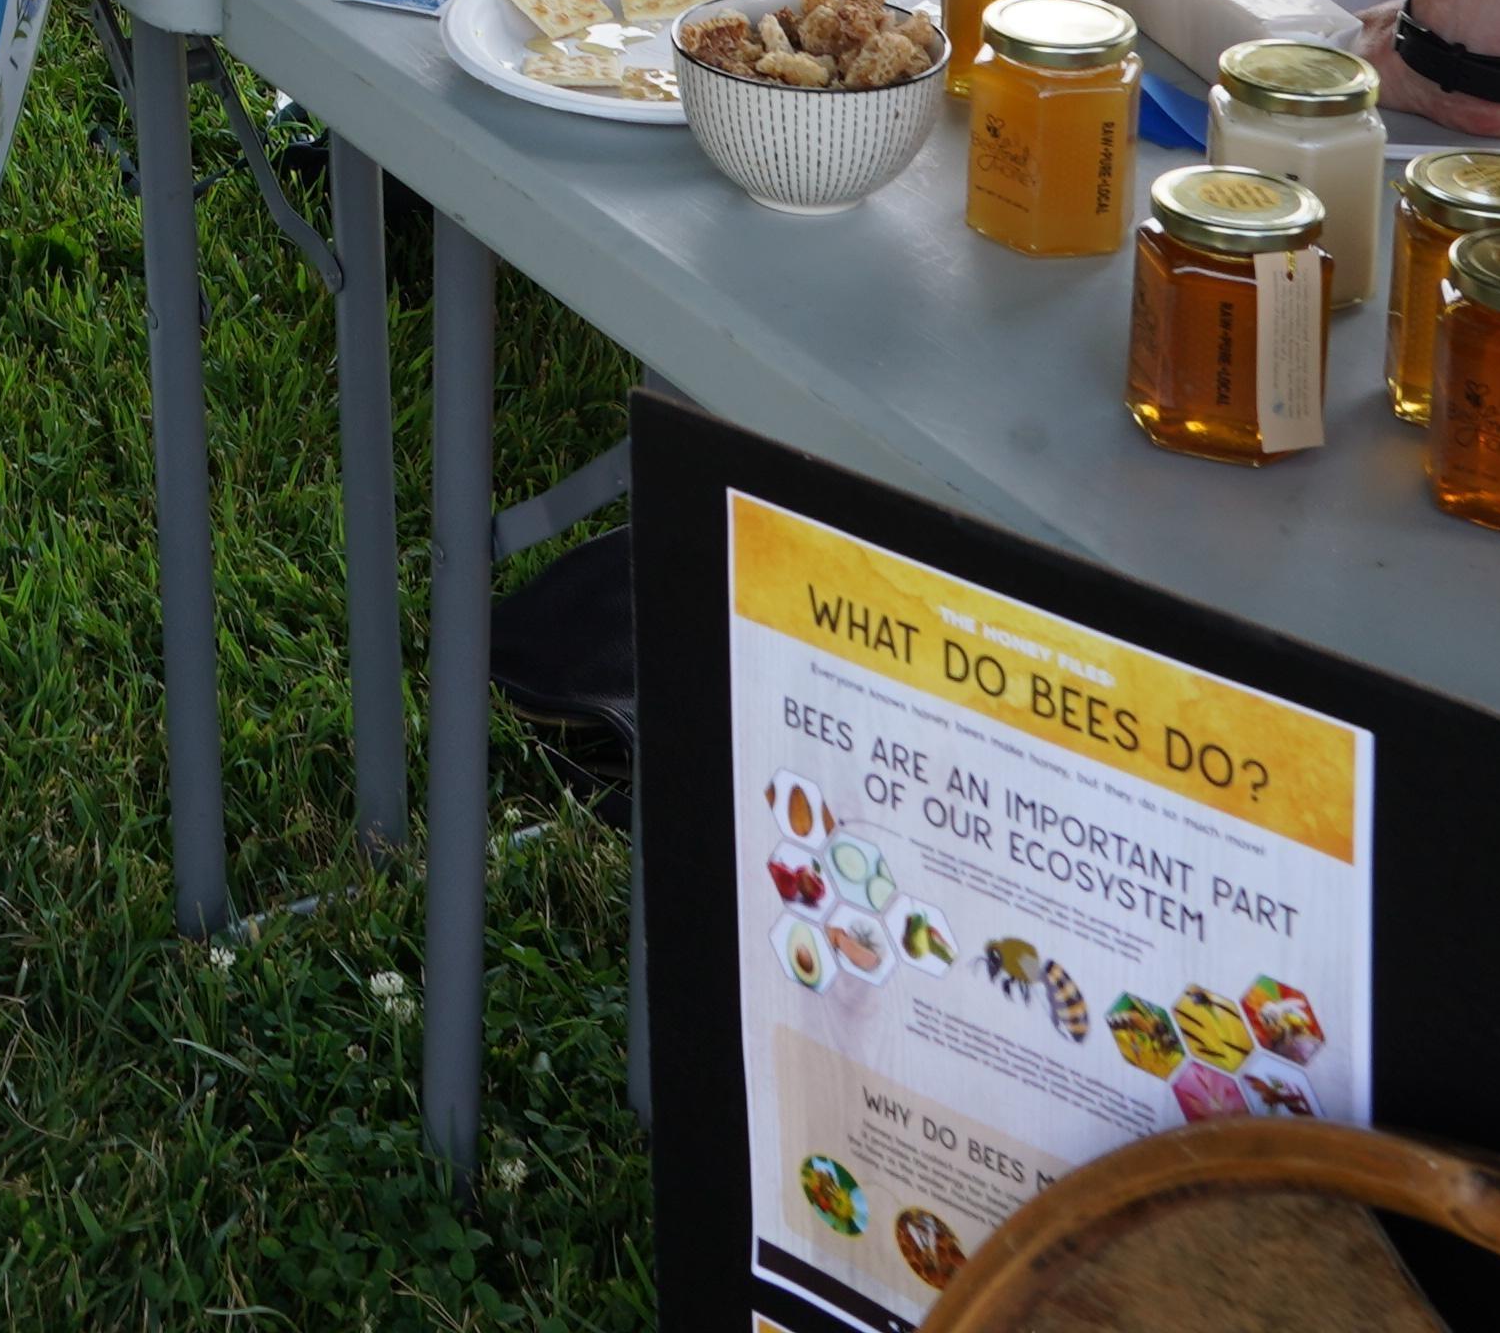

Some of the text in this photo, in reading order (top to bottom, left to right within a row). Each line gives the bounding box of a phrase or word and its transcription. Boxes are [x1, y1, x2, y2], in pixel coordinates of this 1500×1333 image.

[808, 583, 1269, 801] WHAT DO BEES DO?
[982, 623, 1050, 662] HONEY
[784, 696, 853, 752] BEES
[871, 737, 928, 783] ARE
[947, 766, 989, 808] AN
[1006, 789, 1195, 893] IMPORTANT
[1212, 876, 1300, 937] PART
[865, 773, 906, 811] OF
[923, 797, 993, 851] OUR
[1009, 831, 1206, 942] ECOSYSTEM
[863, 1086, 910, 1128] WHY
[923, 1116, 957, 1150] DO
[968, 1137, 1024, 1183] BEES
